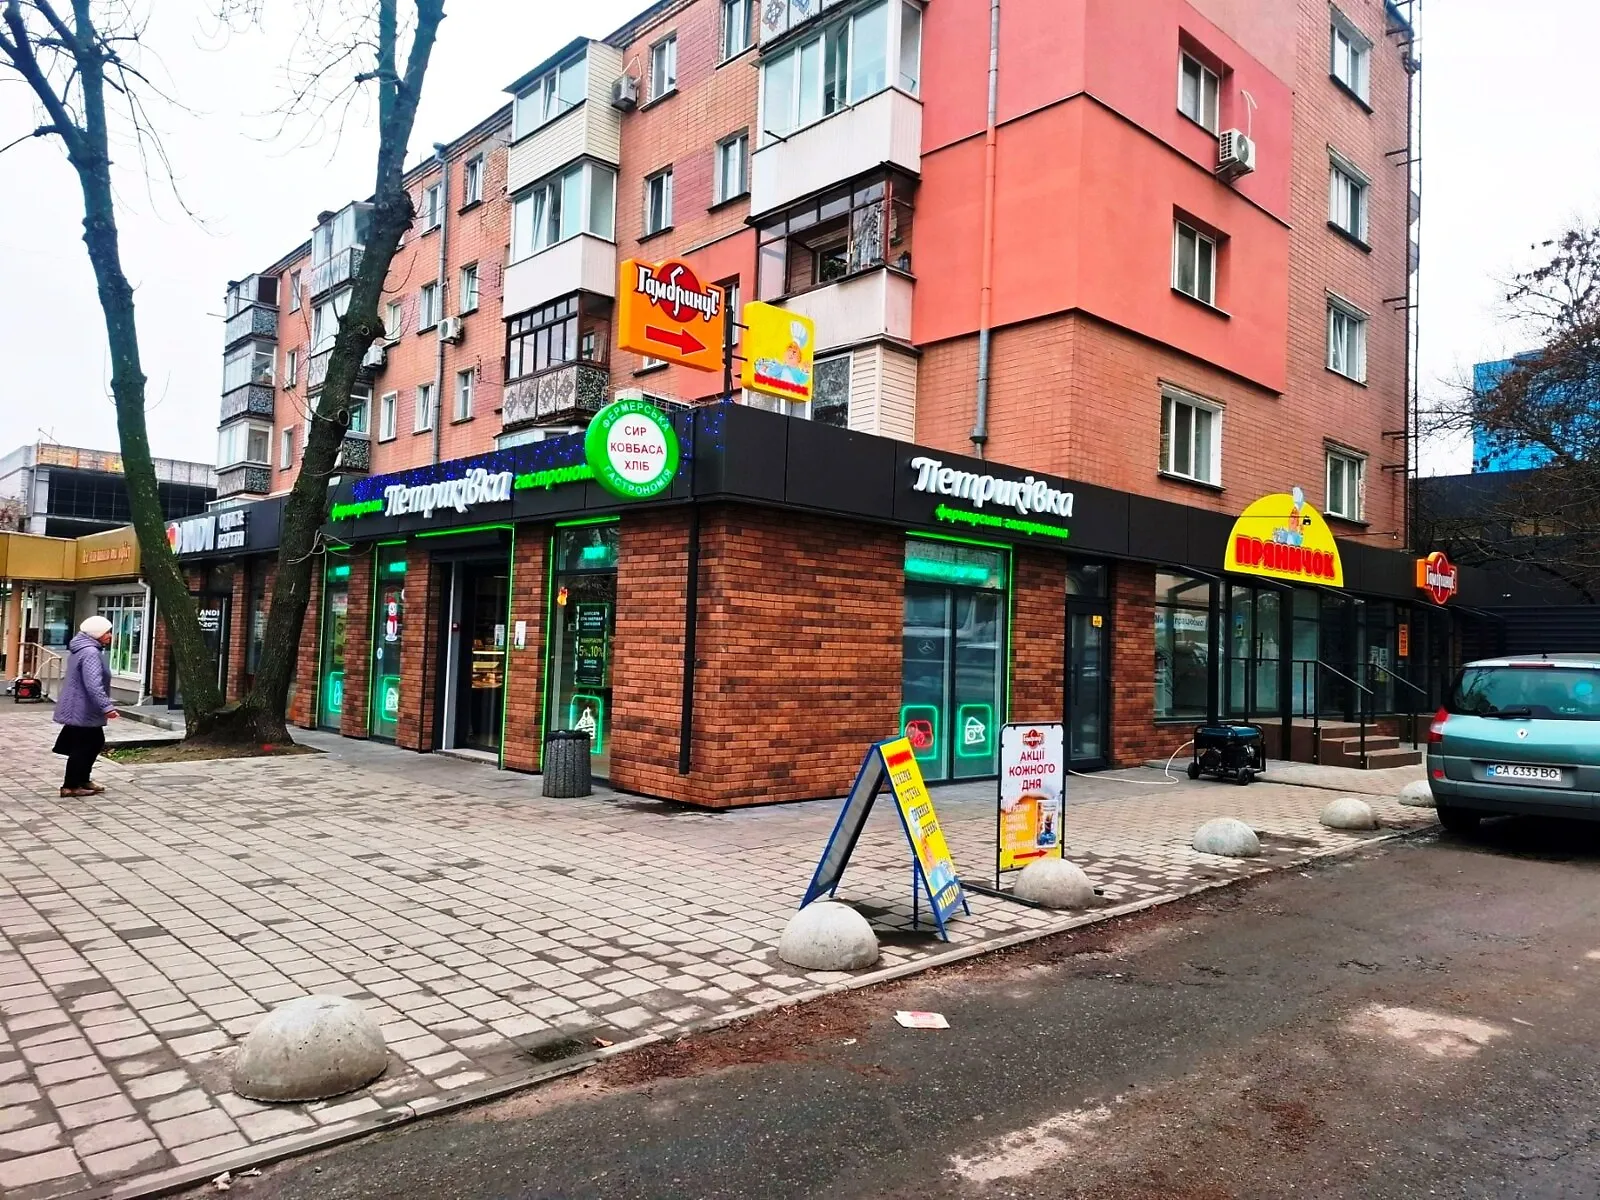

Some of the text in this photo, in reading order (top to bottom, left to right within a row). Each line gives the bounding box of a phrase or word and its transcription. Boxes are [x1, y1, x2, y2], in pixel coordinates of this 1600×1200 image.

[602, 401, 670, 432] ФЕРМЕРСЬКА
[624, 425, 647, 436] СИР
[610, 442, 664, 455] КОВБАСА
[624, 460, 650, 471] ХЛІБ
[604, 465, 672, 495] ГАСТРОНОМІЯ
[911, 457, 1074, 517] Петриківка
[384, 468, 514, 518] Петриківка
[1235, 534, 1335, 580] ПРЯНИЧОК
[1020, 747, 1045, 762] АКЦІЇ
[1009, 763, 1056, 777] КОЖНОГО
[1495, 765, 1509, 775] CA
[1512, 766, 1538, 777] 6333
[1021, 778, 1042, 791] ДНЯ
